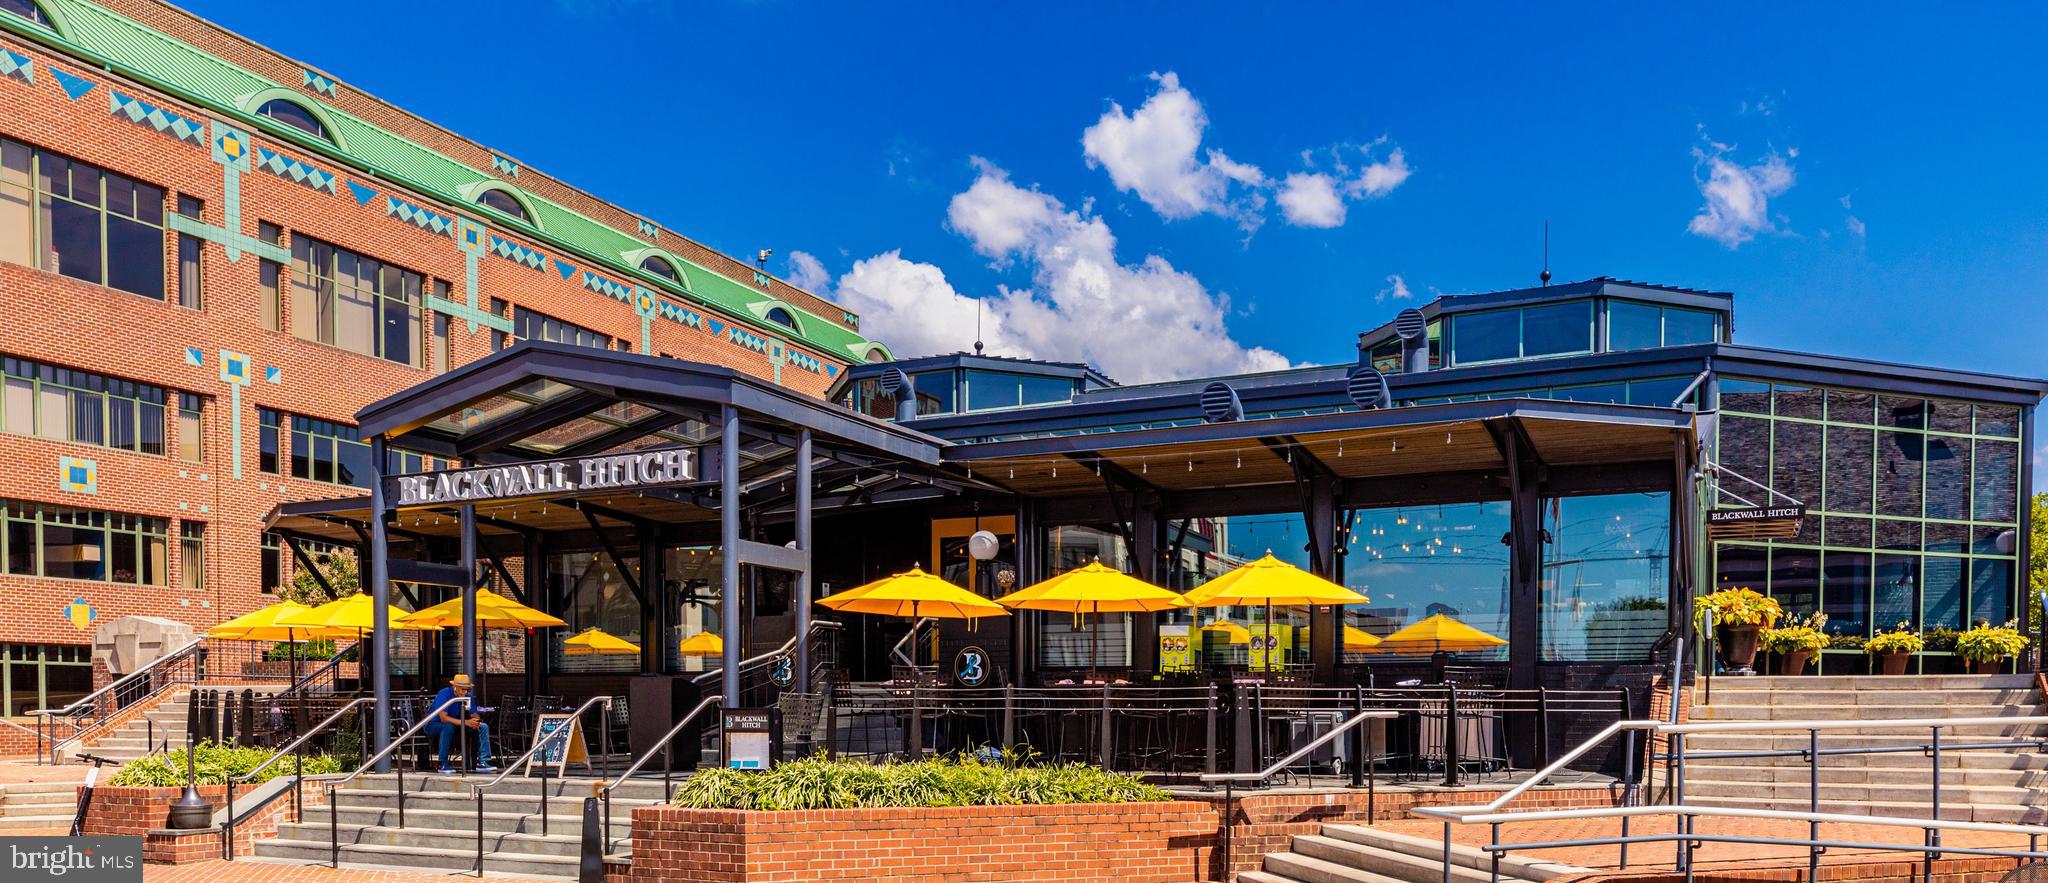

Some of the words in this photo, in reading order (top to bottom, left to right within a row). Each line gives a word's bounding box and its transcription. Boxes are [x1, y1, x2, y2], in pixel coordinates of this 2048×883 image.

[398, 462, 576, 504] BLACKWALL
[579, 450, 695, 489] HITCH
[973, 501, 980, 512] 5
[1712, 510, 1765, 520] BLACKWALL
[1767, 508, 1799, 517] HITCH
